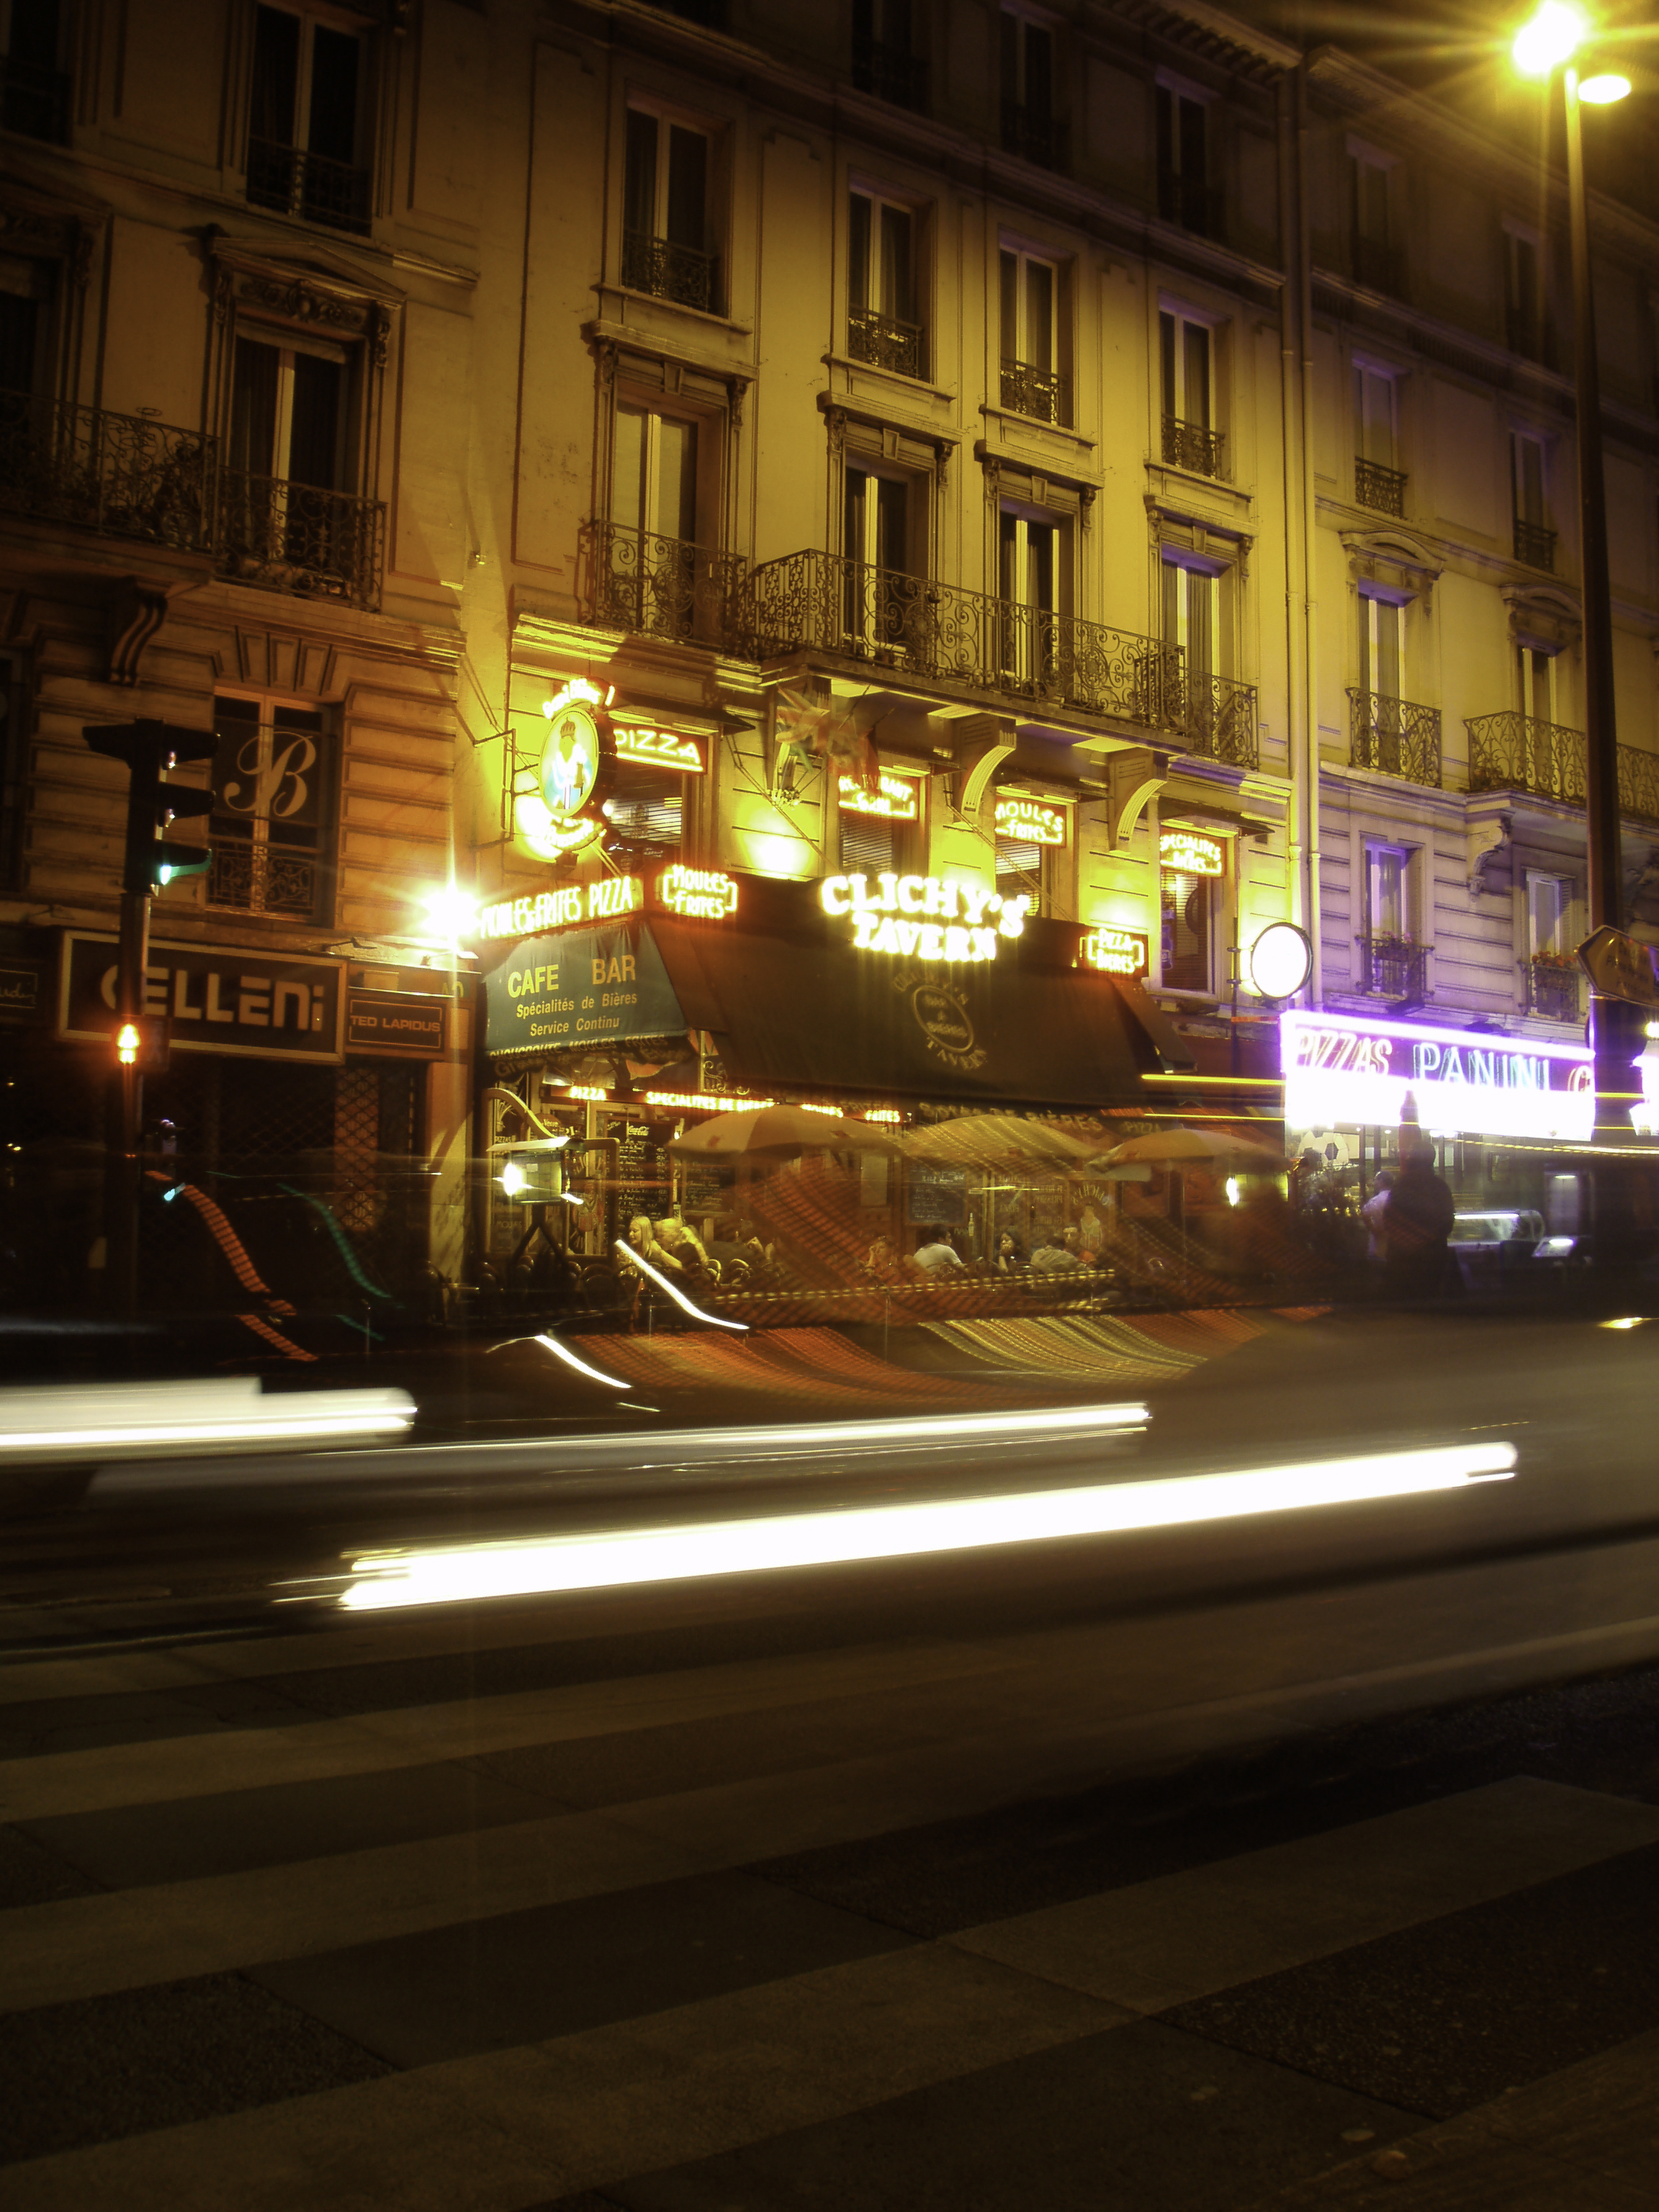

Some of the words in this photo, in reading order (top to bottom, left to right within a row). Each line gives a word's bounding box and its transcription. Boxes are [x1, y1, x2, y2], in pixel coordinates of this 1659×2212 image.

[613, 729, 701, 765] PIZZA
[994, 801, 1064, 832] MOULES
[672, 863, 729, 894] MOULES
[588, 875, 634, 919] PIZZA
[820, 872, 1032, 938] CLICHY'S
[851, 911, 998, 963] TAVERN
[1097, 928, 1134, 952] PIZZA
[507, 963, 559, 998] CAFE
[591, 954, 637, 985] BAR
[516, 997, 575, 1019] Spécialités
[581, 995, 595, 1010] de
[601, 992, 638, 1008] Bières
[350, 1015, 377, 1028] TED
[382, 1017, 441, 1033] LAPIDUS
[530, 1020, 570, 1037] Service
[575, 1015, 620, 1032] Continu
[569, 1037, 617, 1053] MOULES
[1413, 1042, 1551, 1092] PANINI
[569, 1085, 607, 1101] PIZZA
